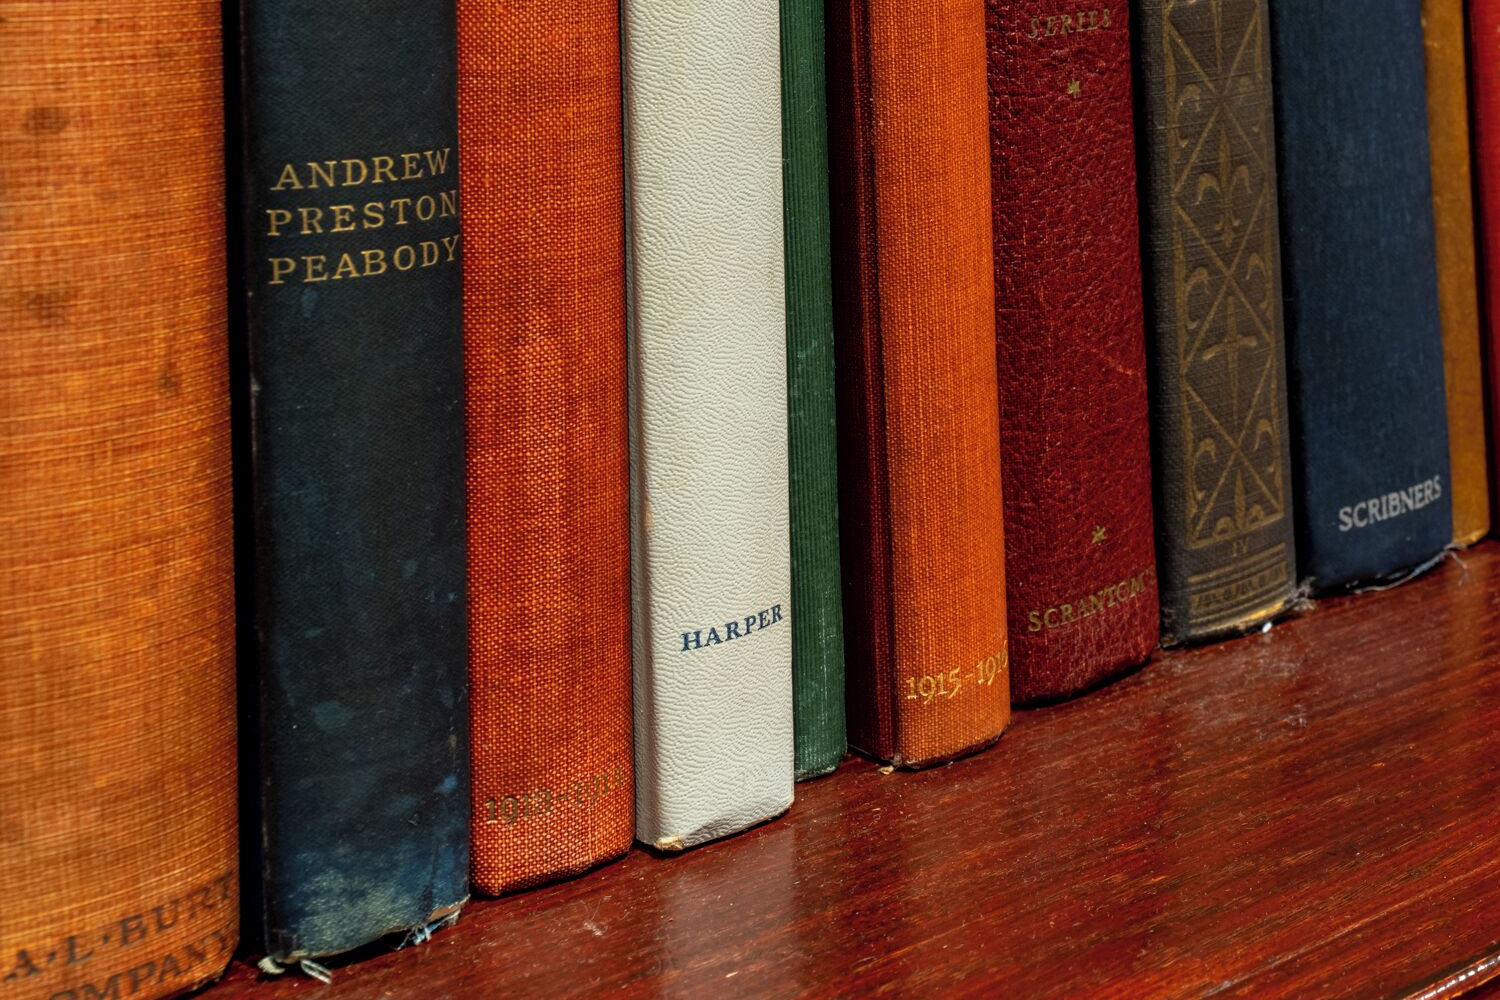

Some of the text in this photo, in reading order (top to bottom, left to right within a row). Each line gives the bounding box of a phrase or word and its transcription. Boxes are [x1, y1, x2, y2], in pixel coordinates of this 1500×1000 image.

[1027, 8, 1111, 40] SERIES
[270, 148, 450, 191] ANDREW
[266, 190, 457, 236] PRESTON
[268, 234, 460, 285] PEABODY
[1338, 474, 1442, 532] SCRIBNERS
[680, 604, 783, 652] HARPER
